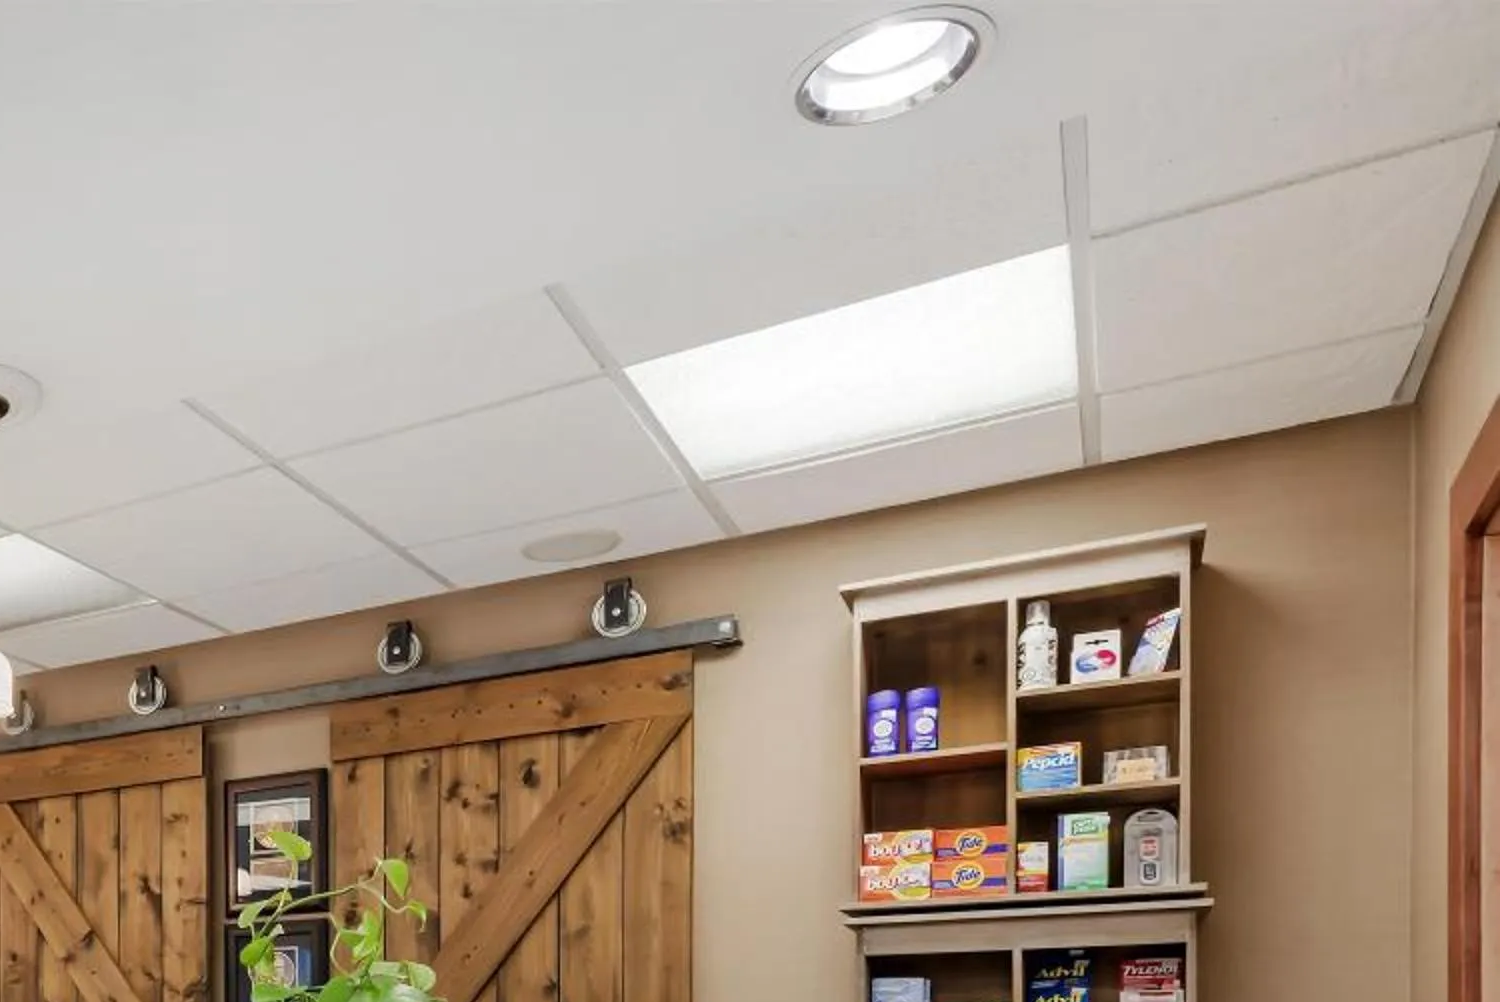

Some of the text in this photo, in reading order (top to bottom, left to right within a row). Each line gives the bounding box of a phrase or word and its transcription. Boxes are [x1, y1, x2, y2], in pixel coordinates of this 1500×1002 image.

[959, 835, 982, 850] Tide
[955, 870, 980, 884] Tide
[1037, 965, 1085, 978] Advil
